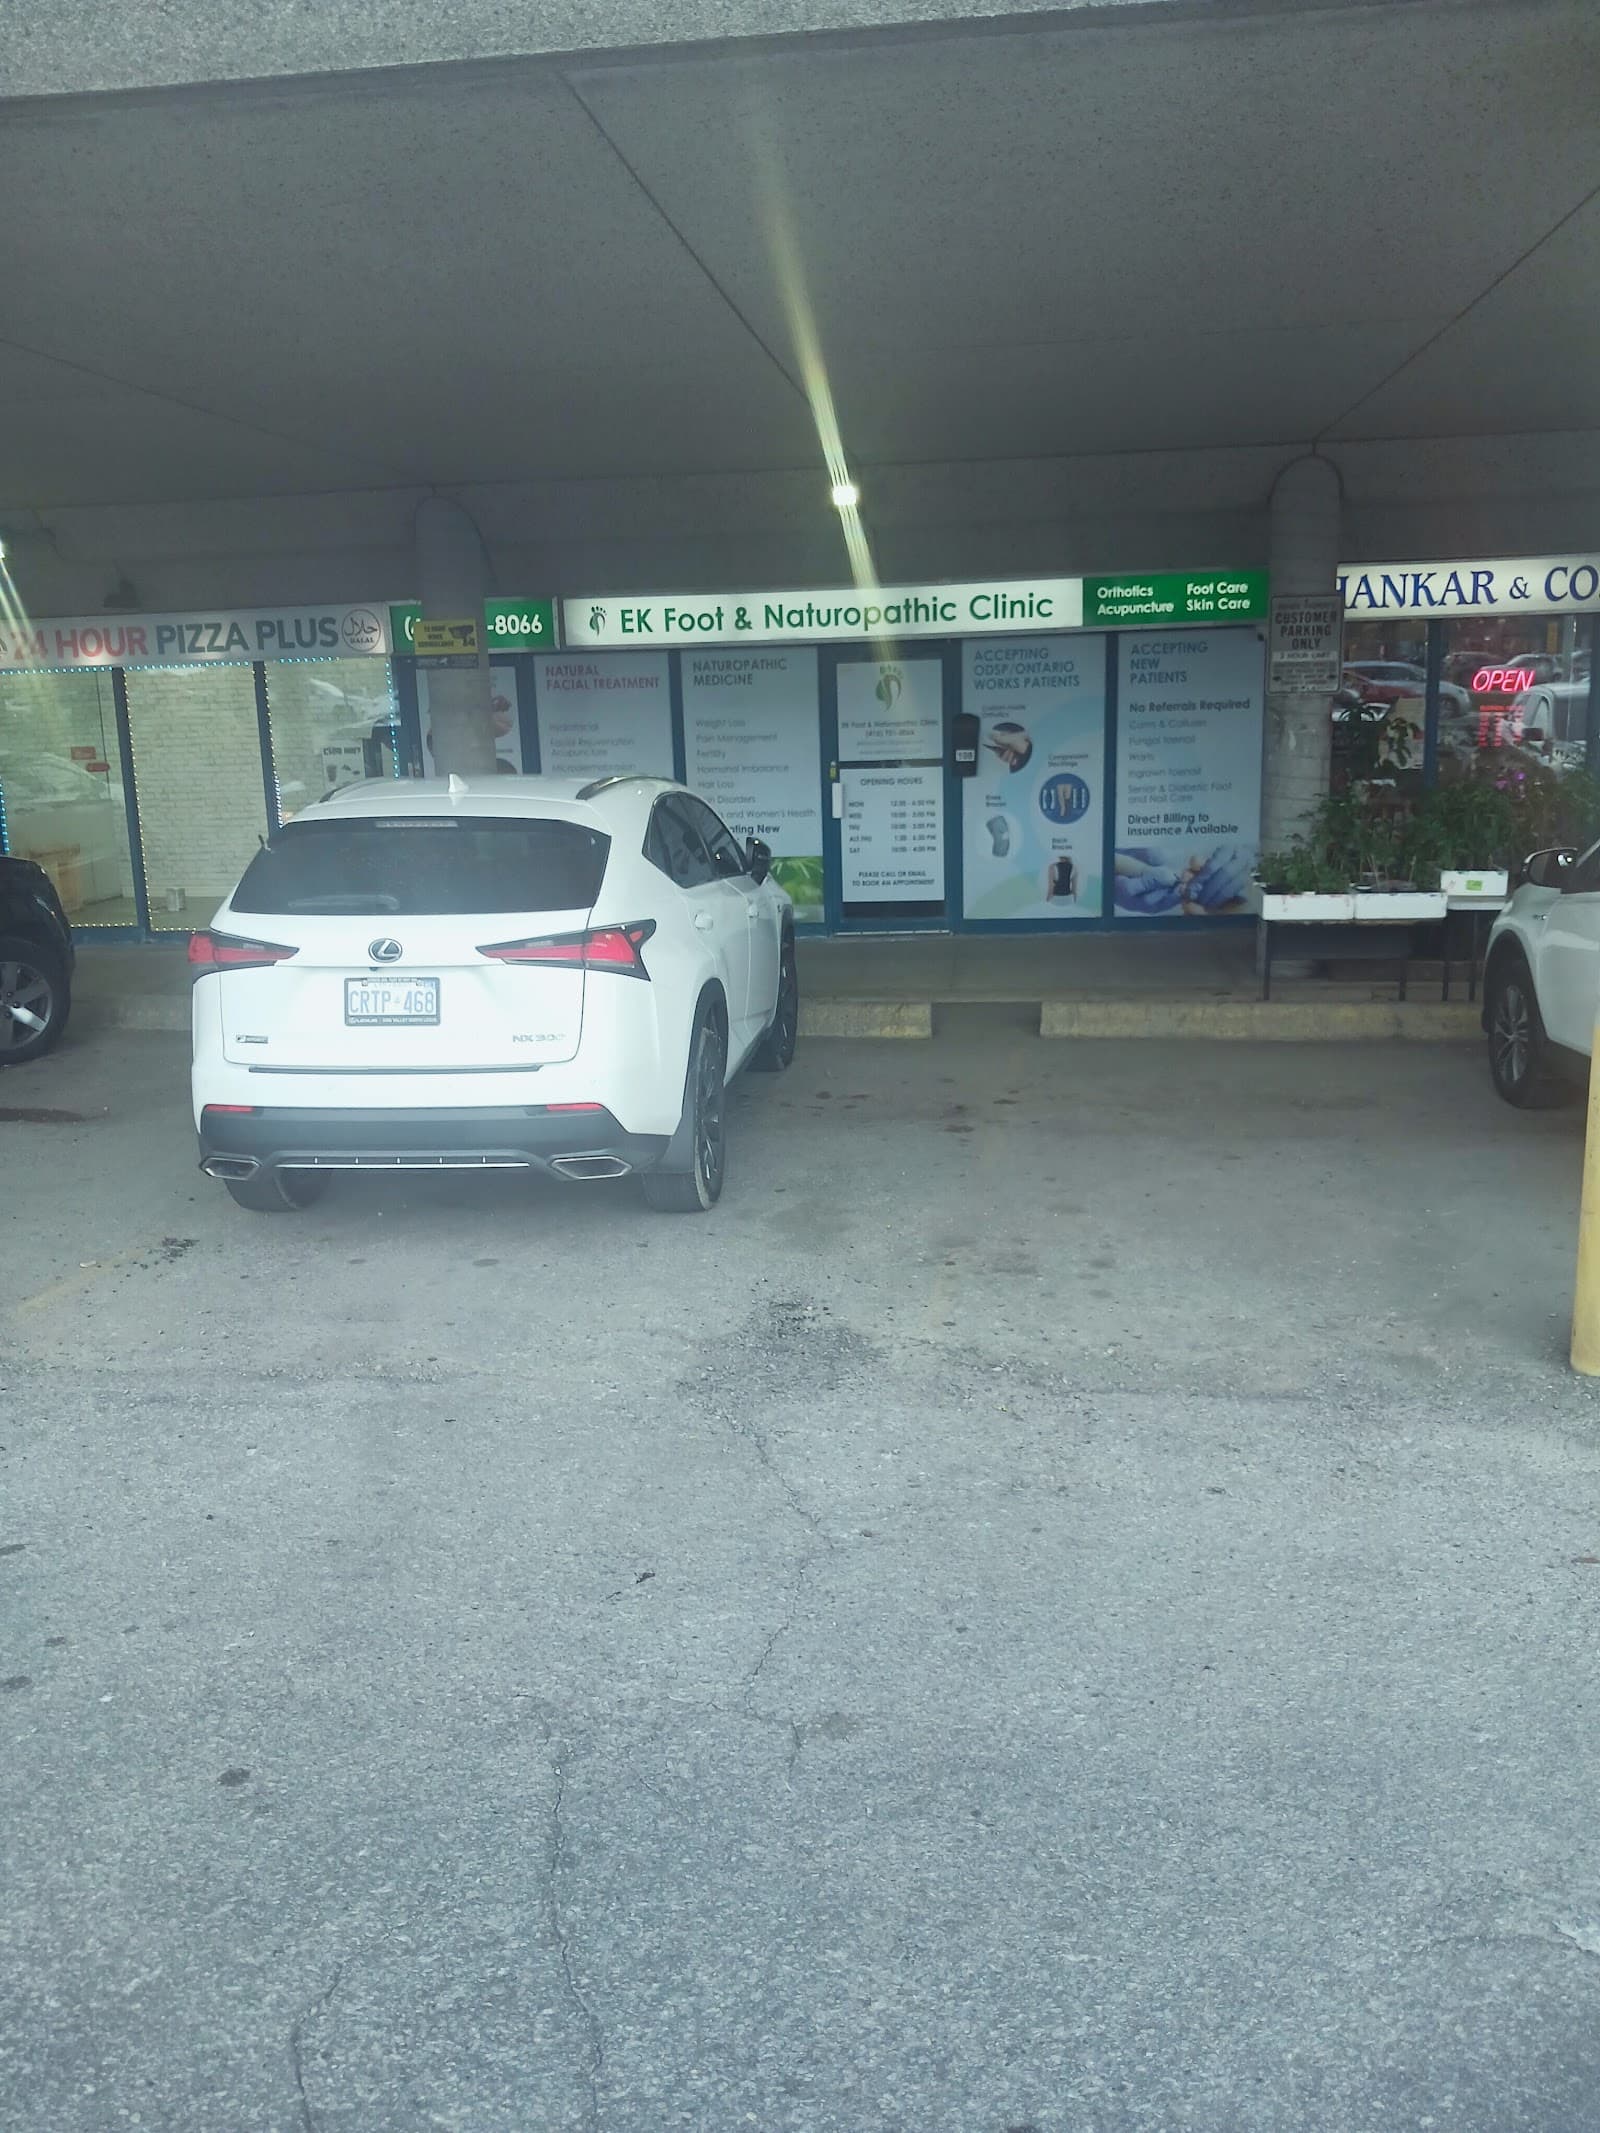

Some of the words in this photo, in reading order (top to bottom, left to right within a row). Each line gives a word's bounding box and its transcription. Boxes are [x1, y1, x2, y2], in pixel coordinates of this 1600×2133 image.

[1097, 585, 1153, 598] Orthotics
[1186, 582, 1214, 595] Foot
[1216, 581, 1248, 594] Care
[1509, 576, 1531, 599] &
[1097, 601, 1174, 616] Acupuncture
[1186, 598, 1214, 611] Skin
[1217, 597, 1250, 610] Care
[620, 608, 653, 633] EK
[664, 606, 724, 632] Foot
[734, 606, 752, 631] &
[764, 596, 957, 631] Naturopathic
[969, 592, 1053, 620] Clinic
[1275, 611, 1337, 624] CUSTOMER
[55, 625, 149, 658] HOUR
[156, 621, 249, 655] PIZZA
[256, 617, 339, 650] PLUS
[1280, 625, 1332, 637] PARKING
[1131, 641, 1208, 655] ACCEPTING
[1292, 638, 1320, 650] ONLY
[975, 647, 1048, 661] ACCEPTING
[693, 658, 788, 672] NATUROPATHIC
[1130, 658, 1160, 670] NEW
[545, 665, 599, 677] NATURAL
[1130, 671, 1187, 684] PATIENTS
[546, 679, 589, 691] FACIAL
[593, 677, 659, 689] TREATMENT
[694, 673, 752, 686] MEDICINE
[974, 678, 1019, 690] WORKS
[1023, 675, 1080, 688] PATIENTS
[1472, 669, 1535, 692] OPEN
[1129, 703, 1145, 712] No
[1148, 701, 1196, 712] Referrals
[1199, 698, 1250, 712] Required
[860, 778, 895, 786] OPENING
[1128, 814, 1160, 825] Direct
[1164, 813, 1196, 825] Billing
[1198, 813, 1209, 823] to
[757, 824, 780, 833] New
[1128, 825, 1182, 836] Insurance
[1185, 824, 1238, 834] Available
[512, 1034, 534, 1042] NX
